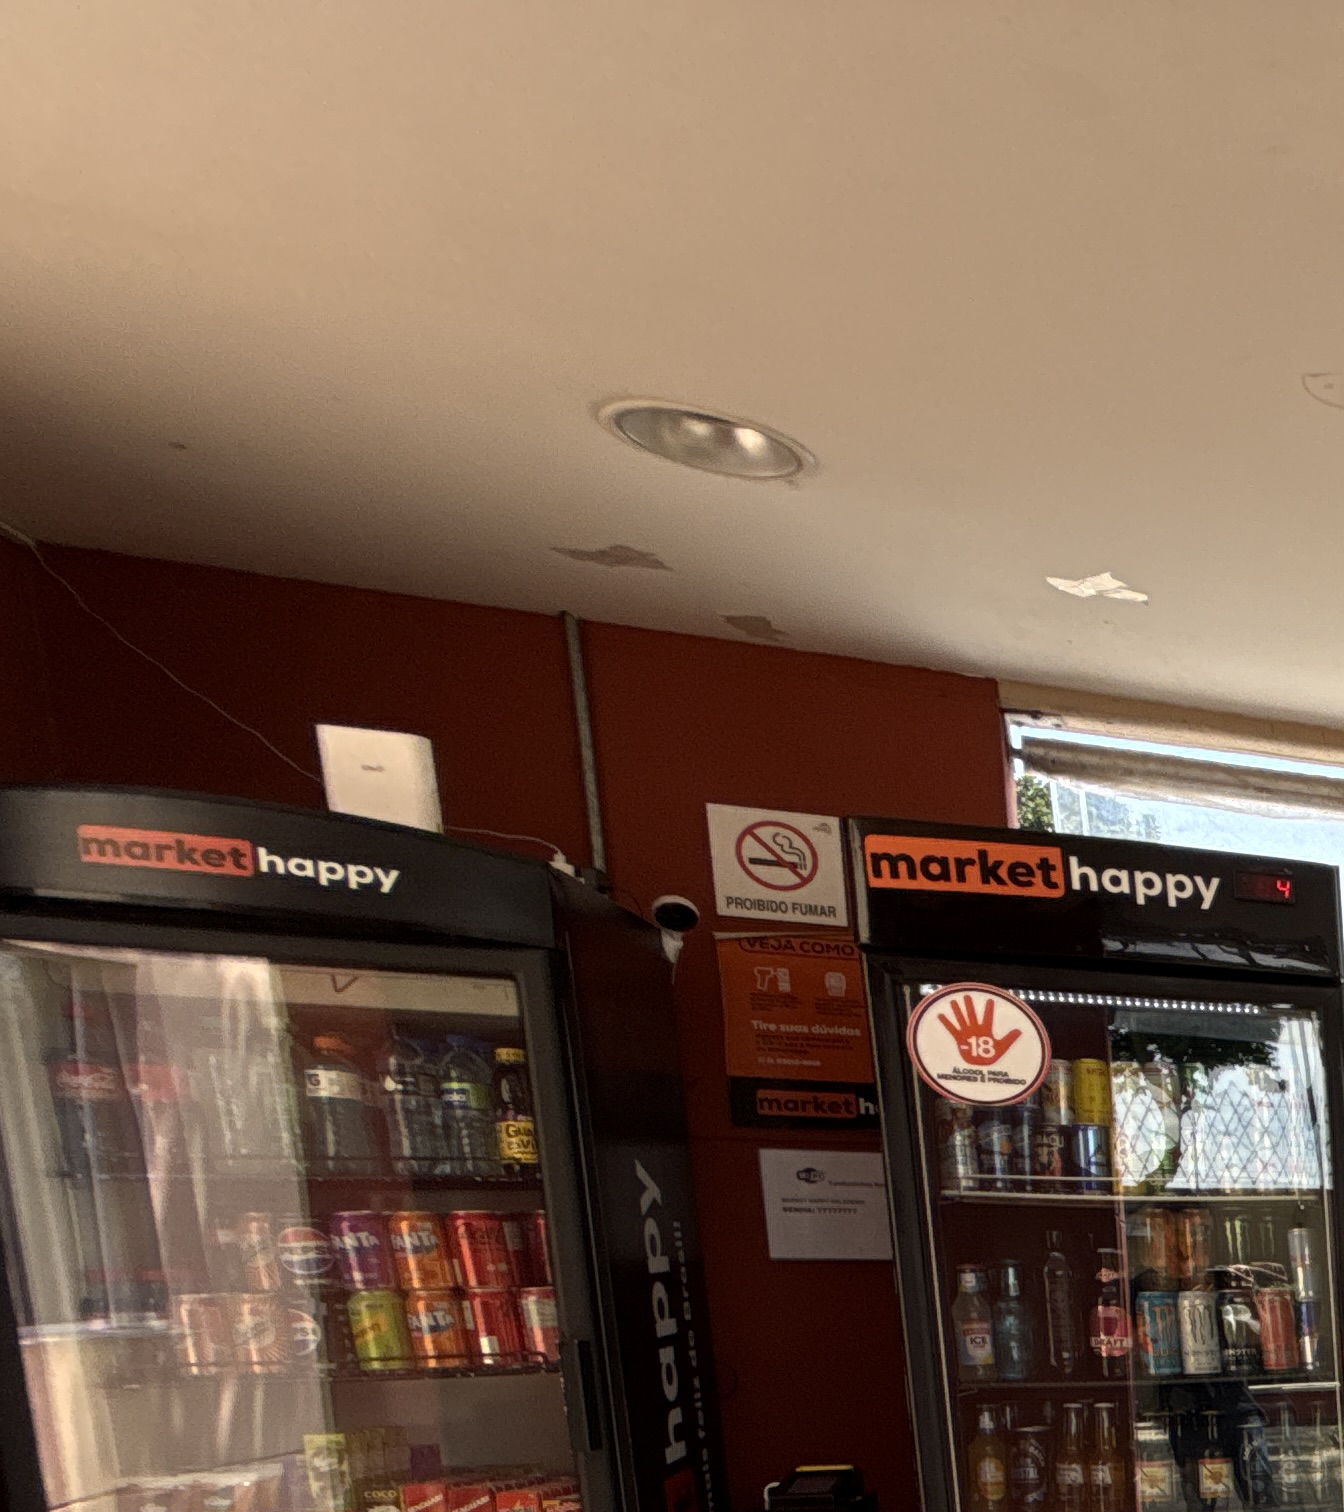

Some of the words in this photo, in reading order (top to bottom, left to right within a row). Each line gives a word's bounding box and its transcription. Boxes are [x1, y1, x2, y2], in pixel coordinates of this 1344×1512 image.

[81, 836, 249, 871] market
[256, 846, 401, 894] happy
[870, 847, 1060, 891] market
[1068, 854, 1221, 911] happy
[1275, 880, 1291, 899] 4
[726, 895, 788, 914] PROIBIDO
[792, 902, 837, 918] FUMAR
[799, 941, 855, 956] COMO
[960, 1035, 996, 1059] -18
[758, 1095, 857, 1116] market
[634, 1158, 688, 1466] happy
